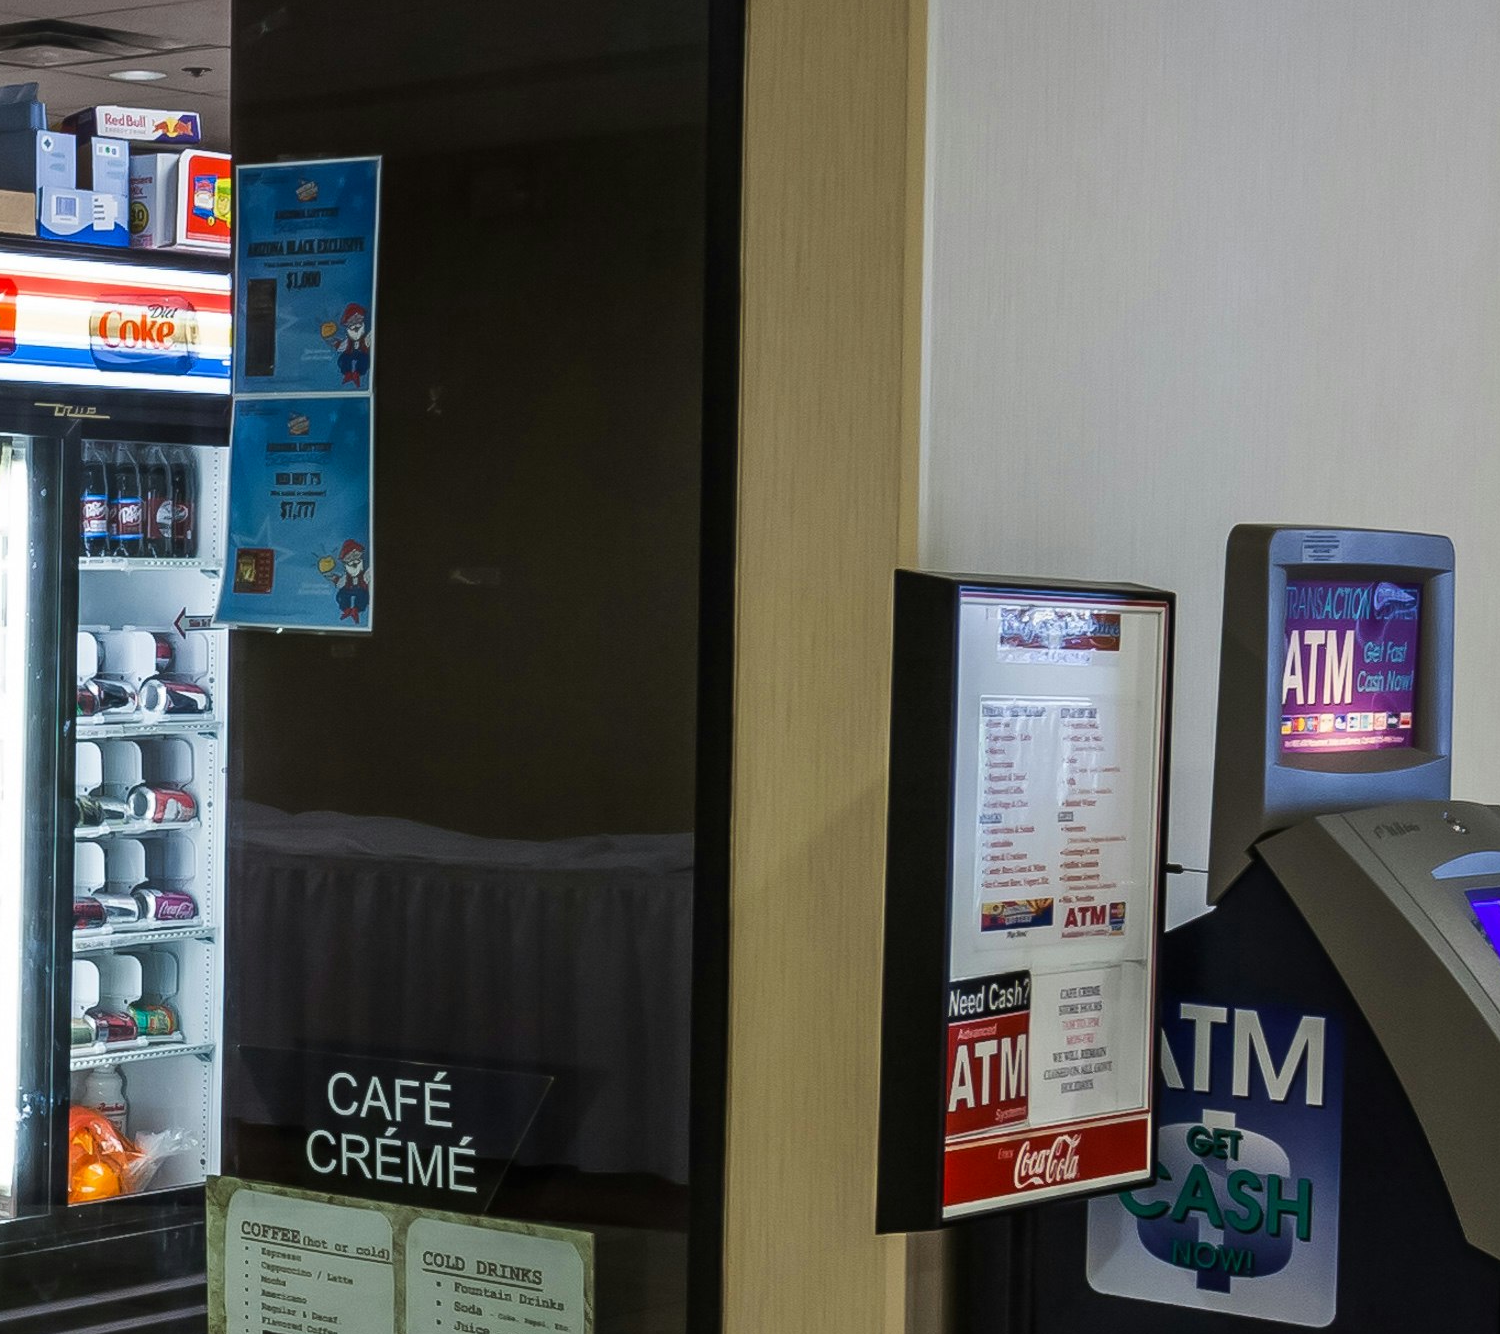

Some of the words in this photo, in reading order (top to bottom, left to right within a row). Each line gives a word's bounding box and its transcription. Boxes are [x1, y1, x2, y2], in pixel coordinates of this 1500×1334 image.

[104, 113, 125, 127] Red
[126, 114, 147, 128] Bull
[100, 311, 176, 350] Coke
[1282, 630, 1355, 705] ATM
[1363, 641, 1384, 663] Get
[1386, 641, 1407, 663] Fast
[1357, 671, 1384, 693] Cash
[1387, 670, 1414, 693] Now!
[1064, 905, 1107, 928] ATM
[949, 985, 985, 1017] Need
[989, 978, 1031, 1010] Cash?
[948, 1033, 1027, 1113] ATM
[327, 1071, 453, 1128] CAFÉ
[306, 1127, 478, 1193] CRÉMÉ
[1014, 1133, 1082, 1189] Coca-Cola
[1187, 1125, 1244, 1161] GET
[1117, 1163, 1315, 1241] CASH
[241, 1221, 301, 1244] COFFEE
[303, 1235, 328, 1250] (hot
[334, 1243, 348, 1253] or
[356, 1246, 390, 1260] cold)
[1170, 1238, 1255, 1276] NOW!
[422, 1250, 465, 1271] COLD
[476, 1260, 543, 1285] DRINKS
[454, 1282, 512, 1302] Fountain
[519, 1294, 565, 1311] Drinks
[454, 1301, 483, 1316] Soda
[262, 1316, 303, 1332] Flavored
